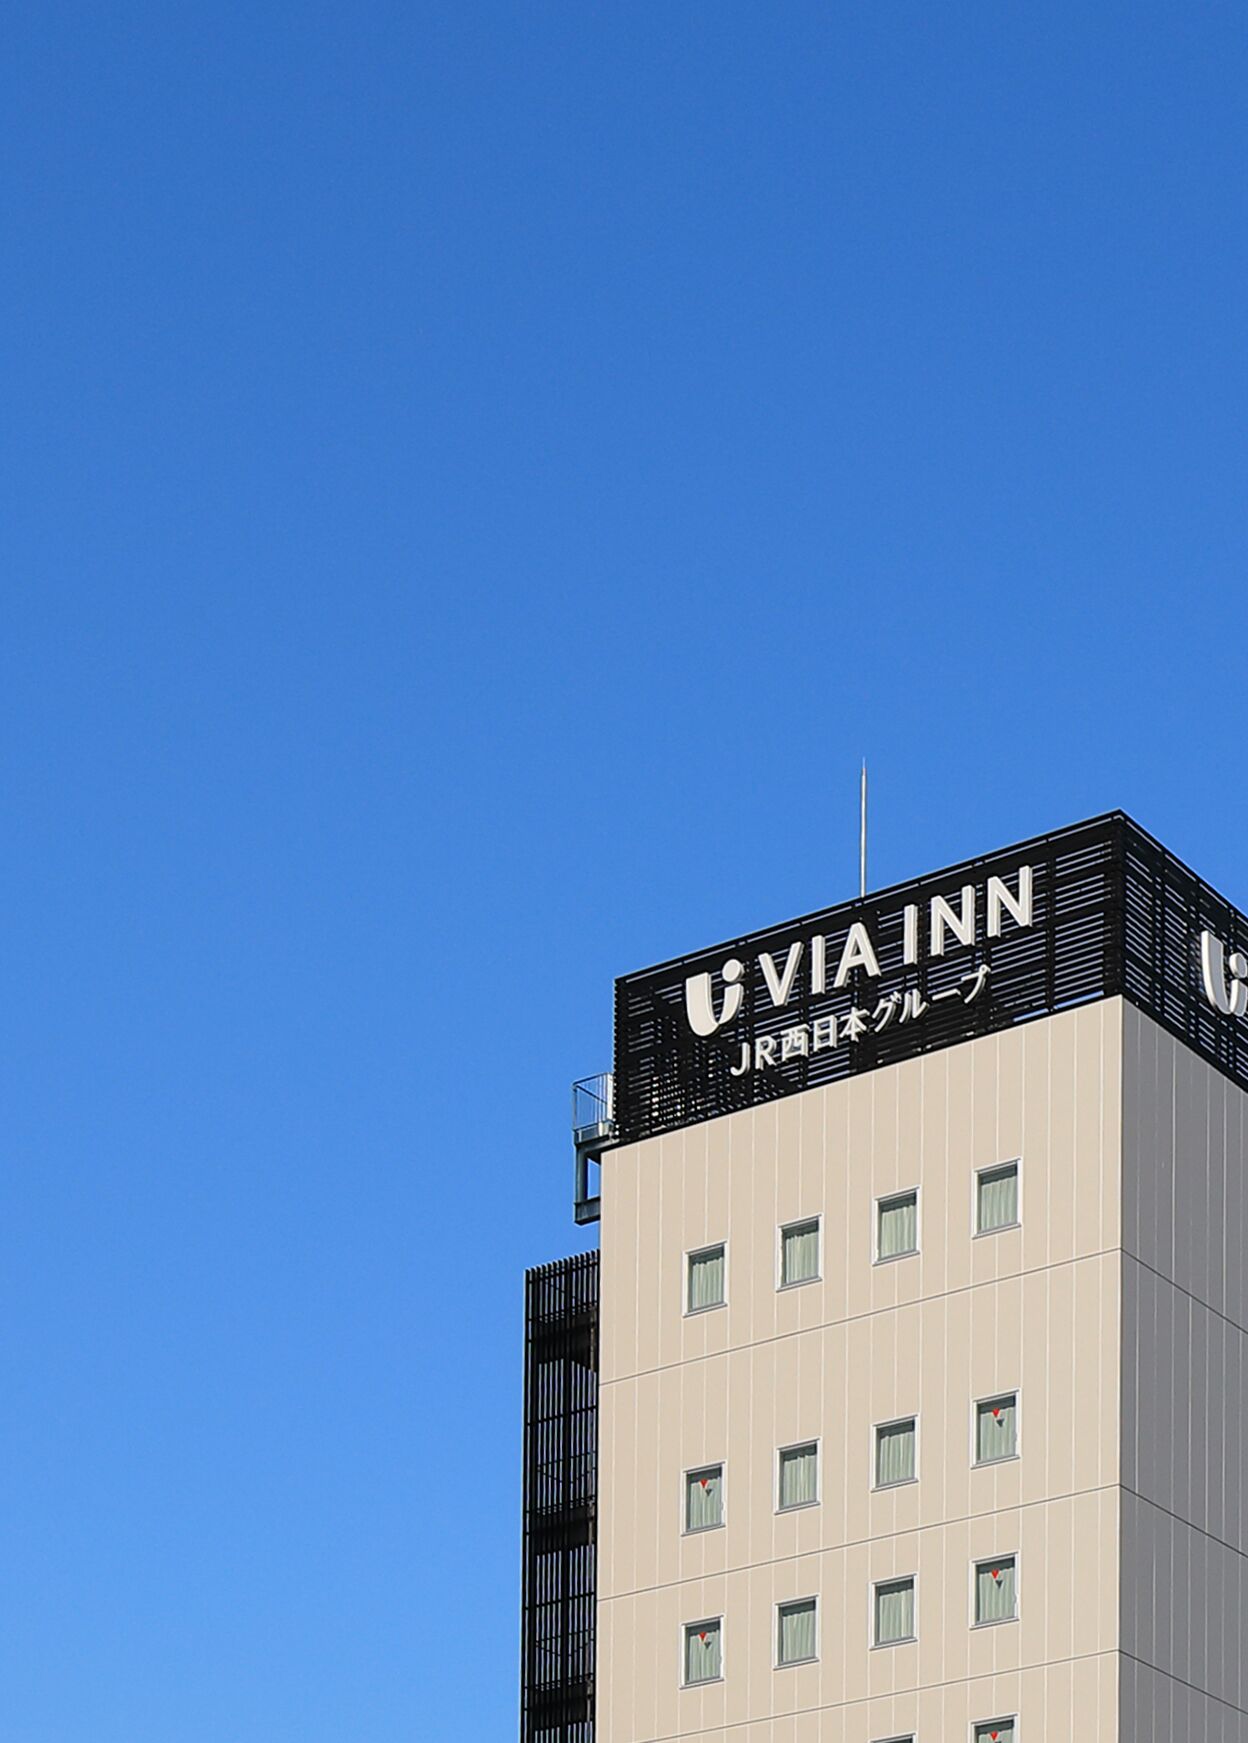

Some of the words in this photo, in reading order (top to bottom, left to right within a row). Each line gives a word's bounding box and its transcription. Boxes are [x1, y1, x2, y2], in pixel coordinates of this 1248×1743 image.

[758, 921, 882, 1007] VIA
[904, 865, 1033, 964] INN
[730, 964, 992, 1076] JR西日本グループ
